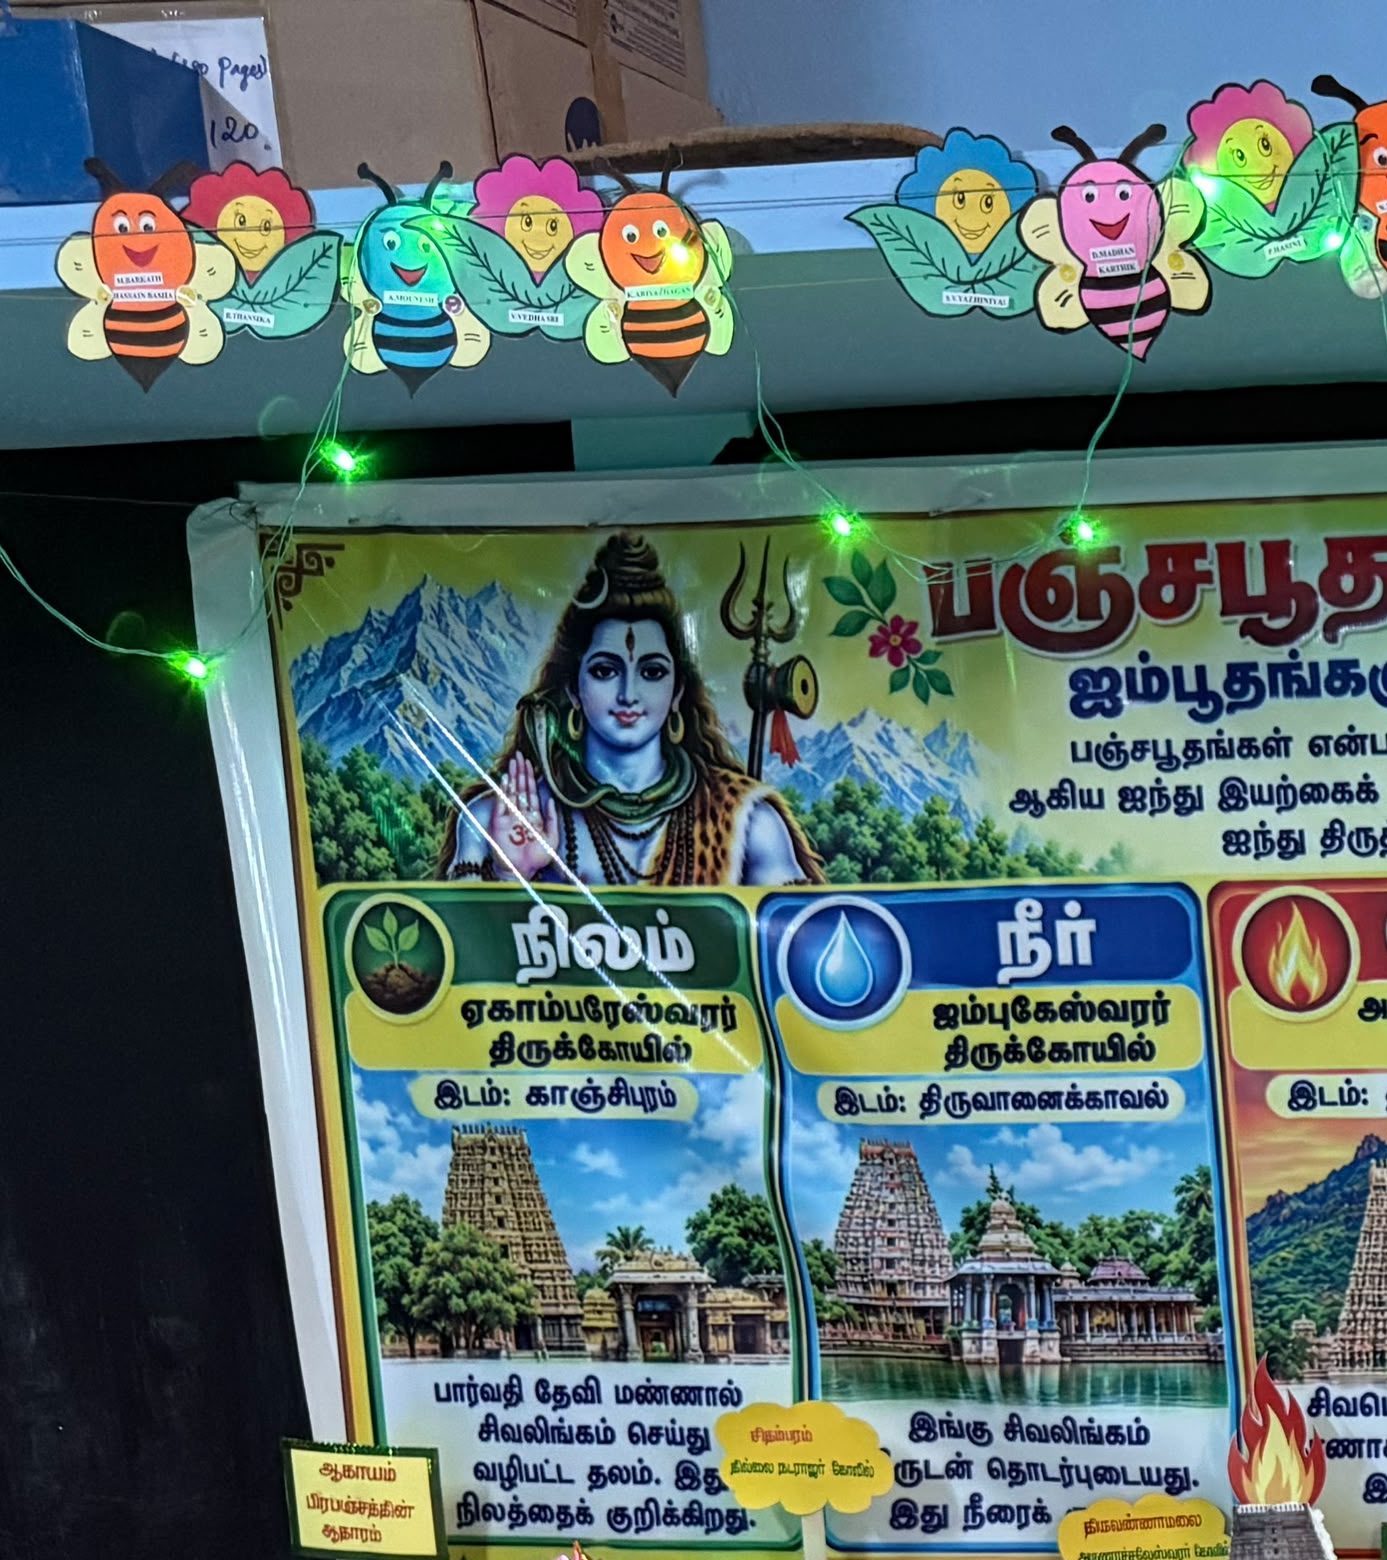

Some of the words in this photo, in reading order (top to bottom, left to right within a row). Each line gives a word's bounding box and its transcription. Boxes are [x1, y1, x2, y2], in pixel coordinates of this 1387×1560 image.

[1070, 726, 1293, 772] பஞ்சபூதங்கள்
[1008, 778, 1105, 815] ஆகிய
[1118, 777, 1205, 816] ஐந்து
[1218, 775, 1380, 811] இயற்கைக்
[1221, 822, 1306, 861] ஐந்து
[512, 898, 696, 986] நிலம்
[996, 898, 1098, 988] நீர்
[460, 990, 738, 1033] ஏகாம்பரேஸ்வரர்
[932, 990, 1171, 1034] ஜம்புகேஸ்வரர்
[490, 1030, 693, 1070] திருக்கோயில்
[945, 1031, 1157, 1072] திருக்கோயில்
[433, 1079, 510, 1112] இடம்:
[526, 1079, 677, 1114] காஞ்சிபுரம்
[833, 1083, 906, 1115] இடம்:
[918, 1081, 1170, 1117] திருவானைக்காவல்
[1286, 1077, 1369, 1111] இடம்:
[434, 1375, 524, 1410] பார்வதி
[535, 1375, 602, 1411] தேவி
[615, 1379, 744, 1408] மண்ணால்
[478, 1414, 616, 1447] சிவலிங்கம்
[628, 1418, 711, 1453] செய்து
[908, 1410, 993, 1447] இங்கு
[1003, 1413, 1151, 1446] சிவலிங்கம்
[319, 1461, 396, 1483] ஆகாயம்
[474, 1456, 575, 1492] வழிபட்ட
[587, 1458, 660, 1491] தலம்.
[987, 1456, 1200, 1494] தொடர்புடையது.
[456, 1494, 595, 1530] நிலத்தைக்
[607, 1498, 757, 1533] குறிக்கிறது.
[889, 1498, 949, 1531] இது
[963, 1493, 1051, 1532] நீரைக்
